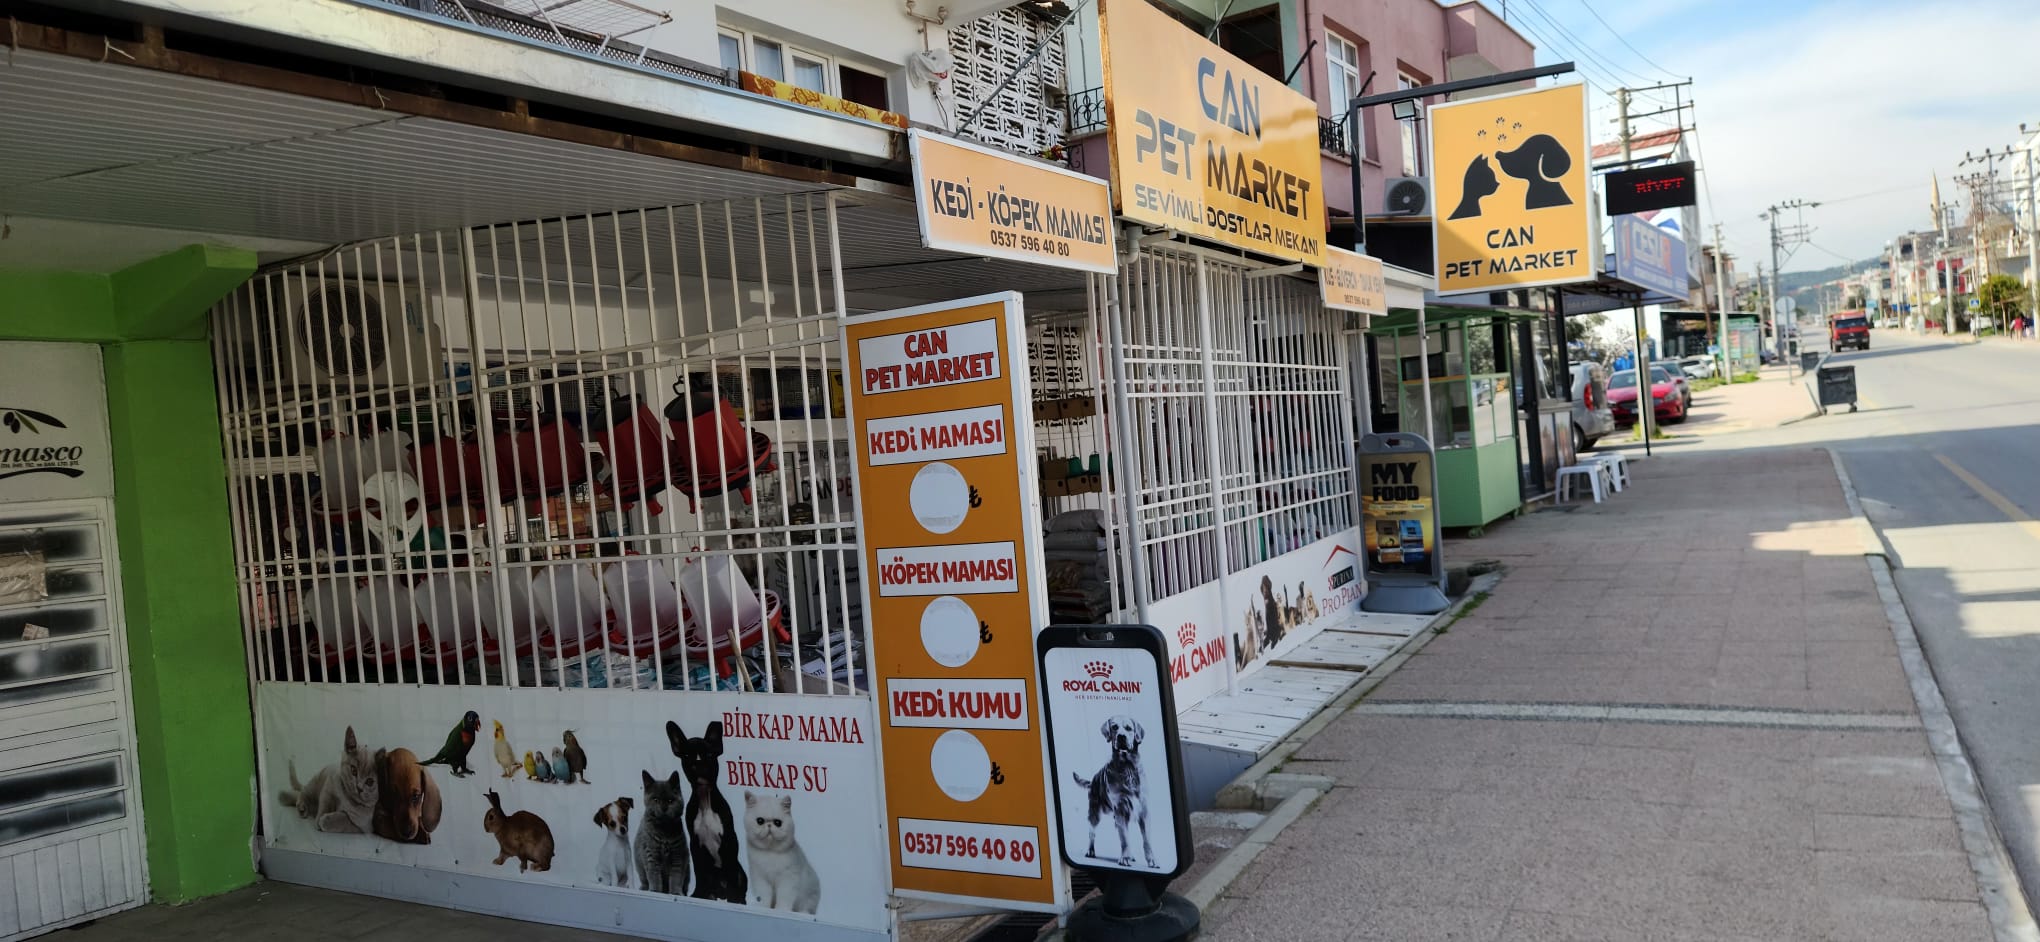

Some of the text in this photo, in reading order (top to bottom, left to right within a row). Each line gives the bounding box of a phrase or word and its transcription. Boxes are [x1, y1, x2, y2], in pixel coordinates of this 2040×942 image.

[1197, 57, 1261, 142] CAN
[1135, 108, 1310, 220] PET MARKET
[931, 176, 974, 220] KEDİ
[987, 184, 1042, 233] KÖPEK
[1046, 204, 1106, 245] MAMASI
[1135, 183, 1318, 256] SEVİMLİ DOSTLAR MEKANI
[990, 229, 1070, 257] 0537 596 40 80
[1486, 225, 1534, 249] CAN
[1445, 249, 1578, 279] PET MARKET
[904, 330, 948, 358] CAN
[865, 352, 994, 391] PET MARKET
[920, 419, 1002, 450] MAMASI
[1371, 462, 1418, 485] MY
[1372, 485, 1420, 502] FOOD
[880, 556, 940, 585] KÖPEK
[943, 558, 1014, 582] MAMASI
[1322, 594, 1341, 617] PRO
[1169, 635, 1226, 684] YAL CANIN
[1062, 680, 1140, 694] ROYAL CANIN
[949, 691, 1022, 720] KUMU
[722, 706, 864, 744] BİR KAP MAMA
[726, 755, 828, 793] BİR KAP SU
[905, 832, 1034, 863] 0537 596 40 80
